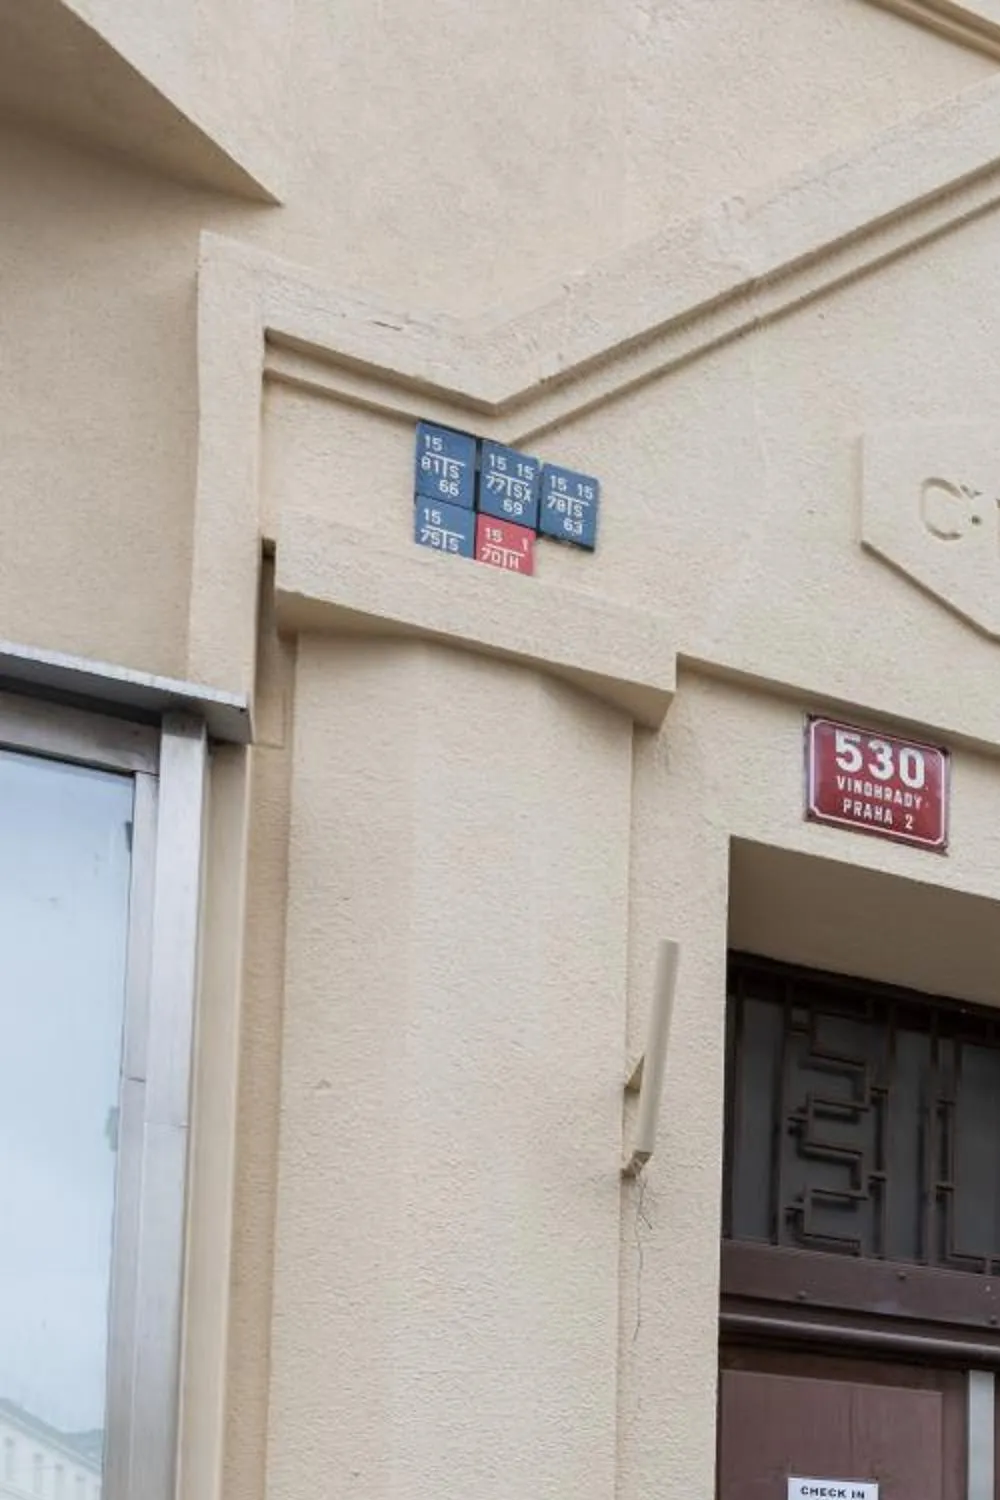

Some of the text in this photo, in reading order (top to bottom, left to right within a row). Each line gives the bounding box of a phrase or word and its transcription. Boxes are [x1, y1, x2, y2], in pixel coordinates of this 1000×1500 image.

[424, 434, 443, 451] 15
[489, 453, 534, 481] 15 15
[551, 475, 594, 500] 15 15
[423, 508, 441, 525] 15
[484, 527, 502, 543] 15
[835, 729, 925, 789] 530
[836, 775, 923, 810] VINOHRADY
[843, 798, 914, 829] PRAHA 2
[800, 1486, 865, 1499] CHECK IN
